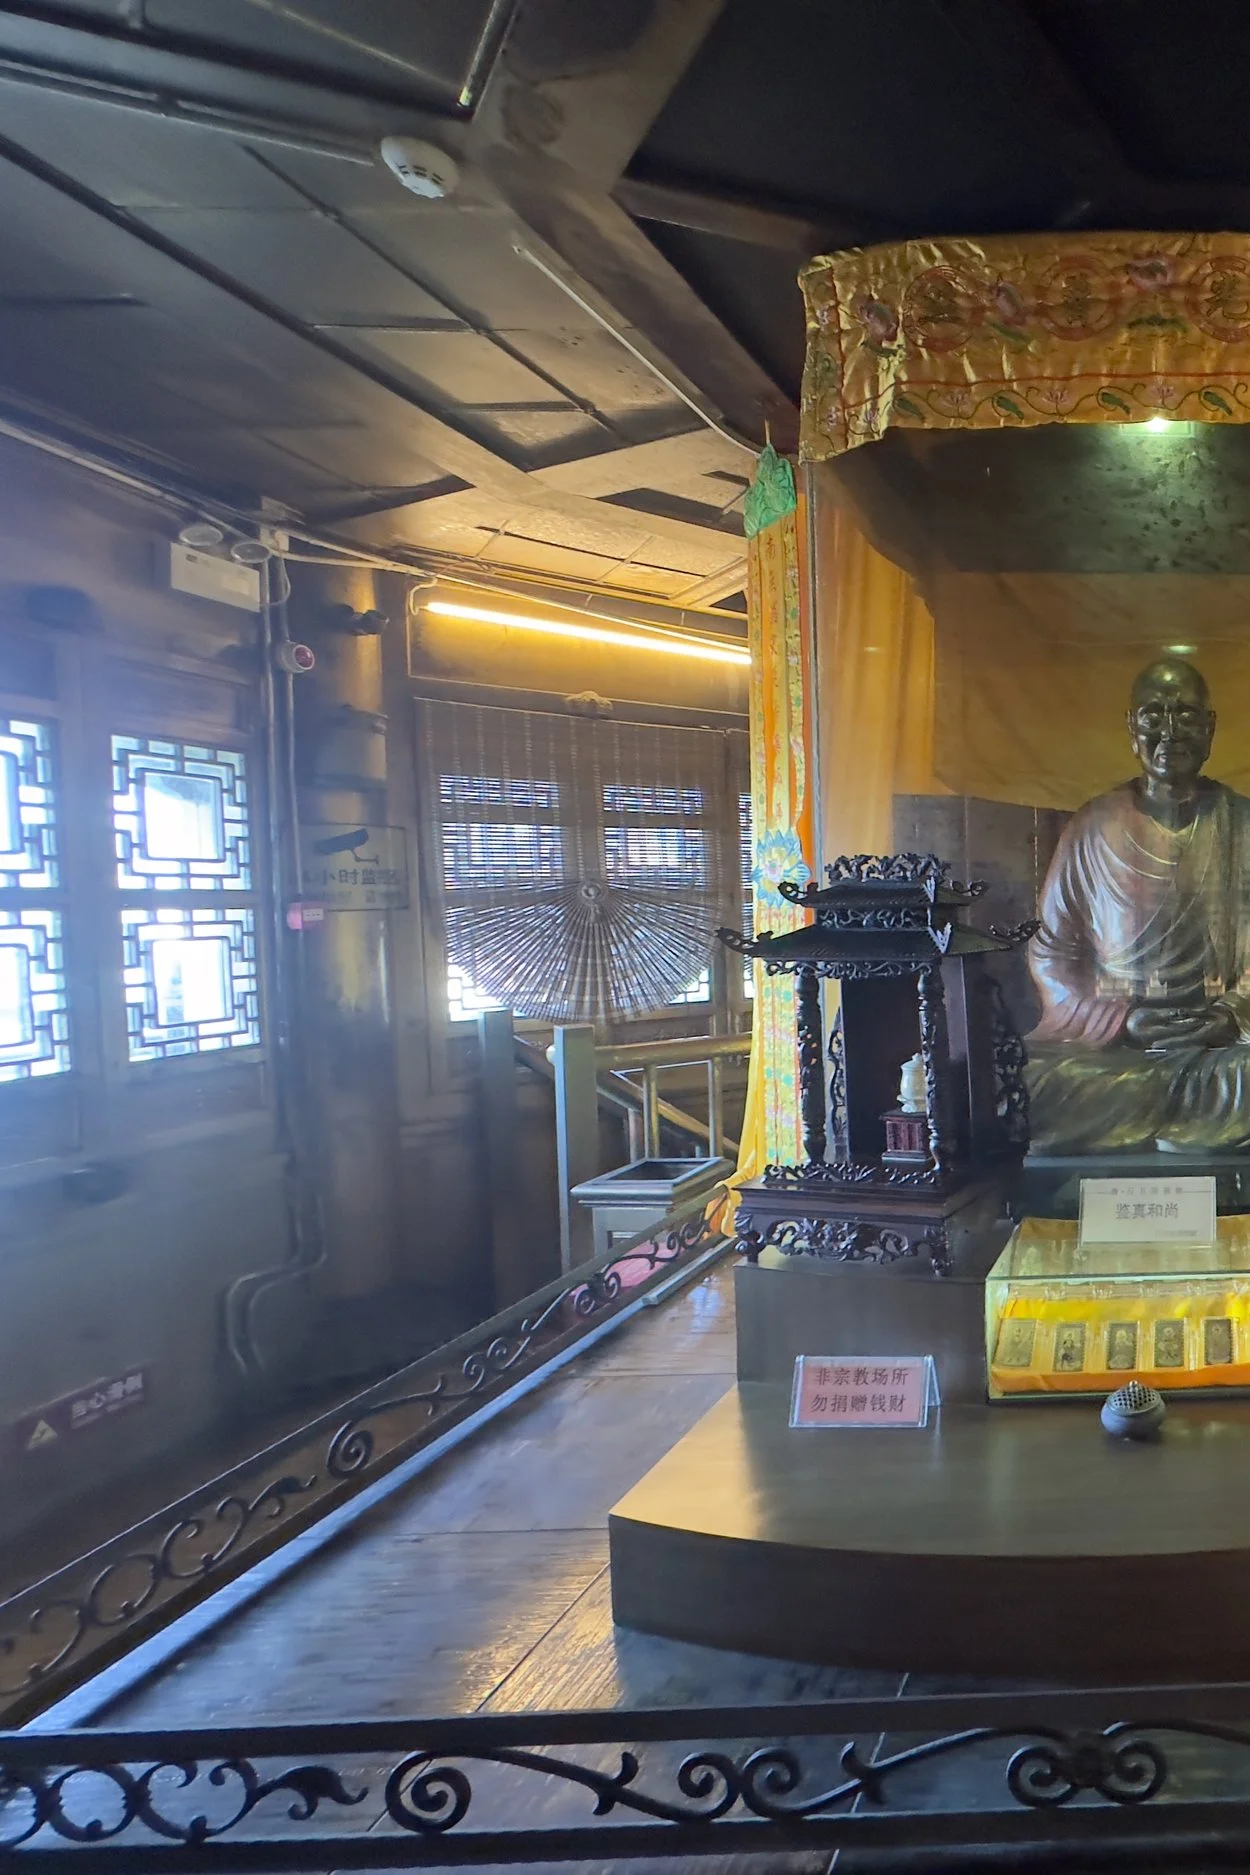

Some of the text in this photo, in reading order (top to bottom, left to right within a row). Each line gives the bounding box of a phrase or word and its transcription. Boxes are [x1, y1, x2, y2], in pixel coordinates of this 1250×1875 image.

[1115, 1202, 1180, 1220] 鉴真和尚
[816, 1367, 909, 1386] 非宗教场所
[811, 1394, 906, 1413] 勿捐赠钱财
